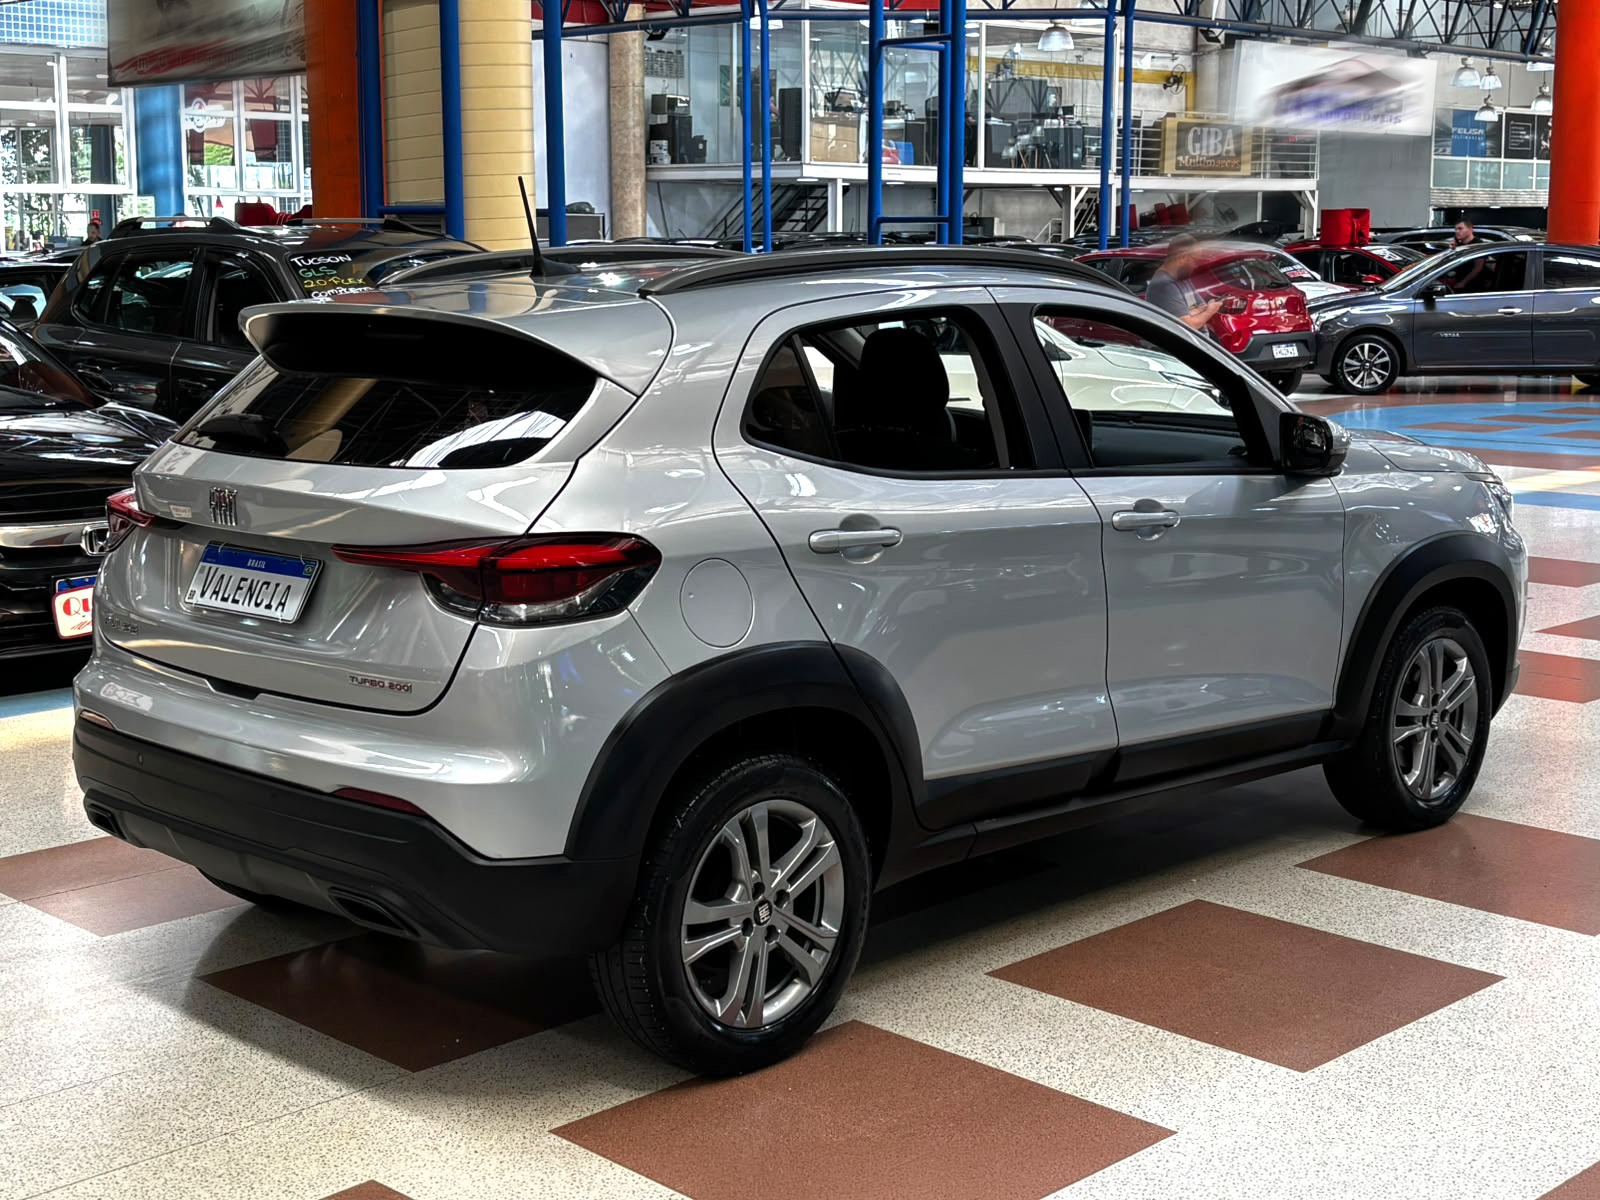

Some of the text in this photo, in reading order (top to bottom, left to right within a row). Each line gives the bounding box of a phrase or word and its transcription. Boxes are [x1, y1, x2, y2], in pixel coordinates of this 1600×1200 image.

[1187, 126, 1237, 157] GIBA
[290, 254, 352, 267] TUCSON
[298, 266, 337, 278] GLS
[247, 558, 266, 569] BRASIL
[199, 566, 292, 613] VALENCIA
